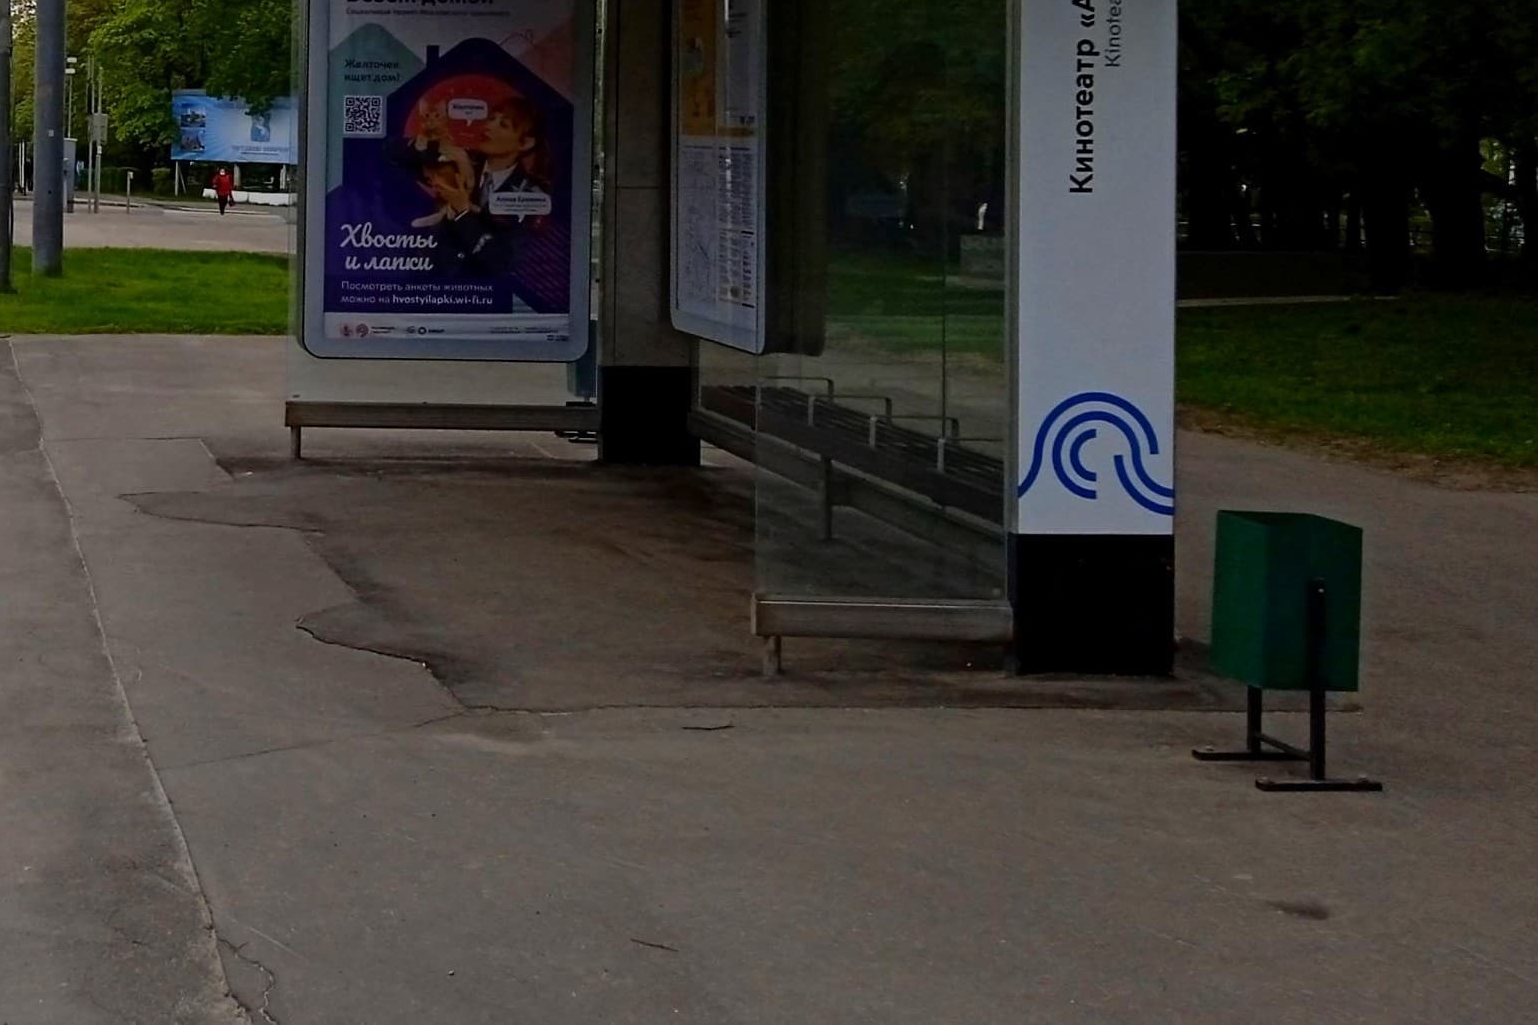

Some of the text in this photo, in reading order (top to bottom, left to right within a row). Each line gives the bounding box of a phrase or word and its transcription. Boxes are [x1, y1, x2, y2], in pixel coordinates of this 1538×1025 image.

[344, 73, 371, 83] ищет
[1069, 38, 1100, 194] Кинотеатр
[340, 222, 438, 248] Хвосты
[345, 255, 435, 271] и лапки
[341, 280, 494, 293] Посмотреть анкеты животных
[340, 294, 494, 306] можно на hvostyilapki.wi-fi.ru
